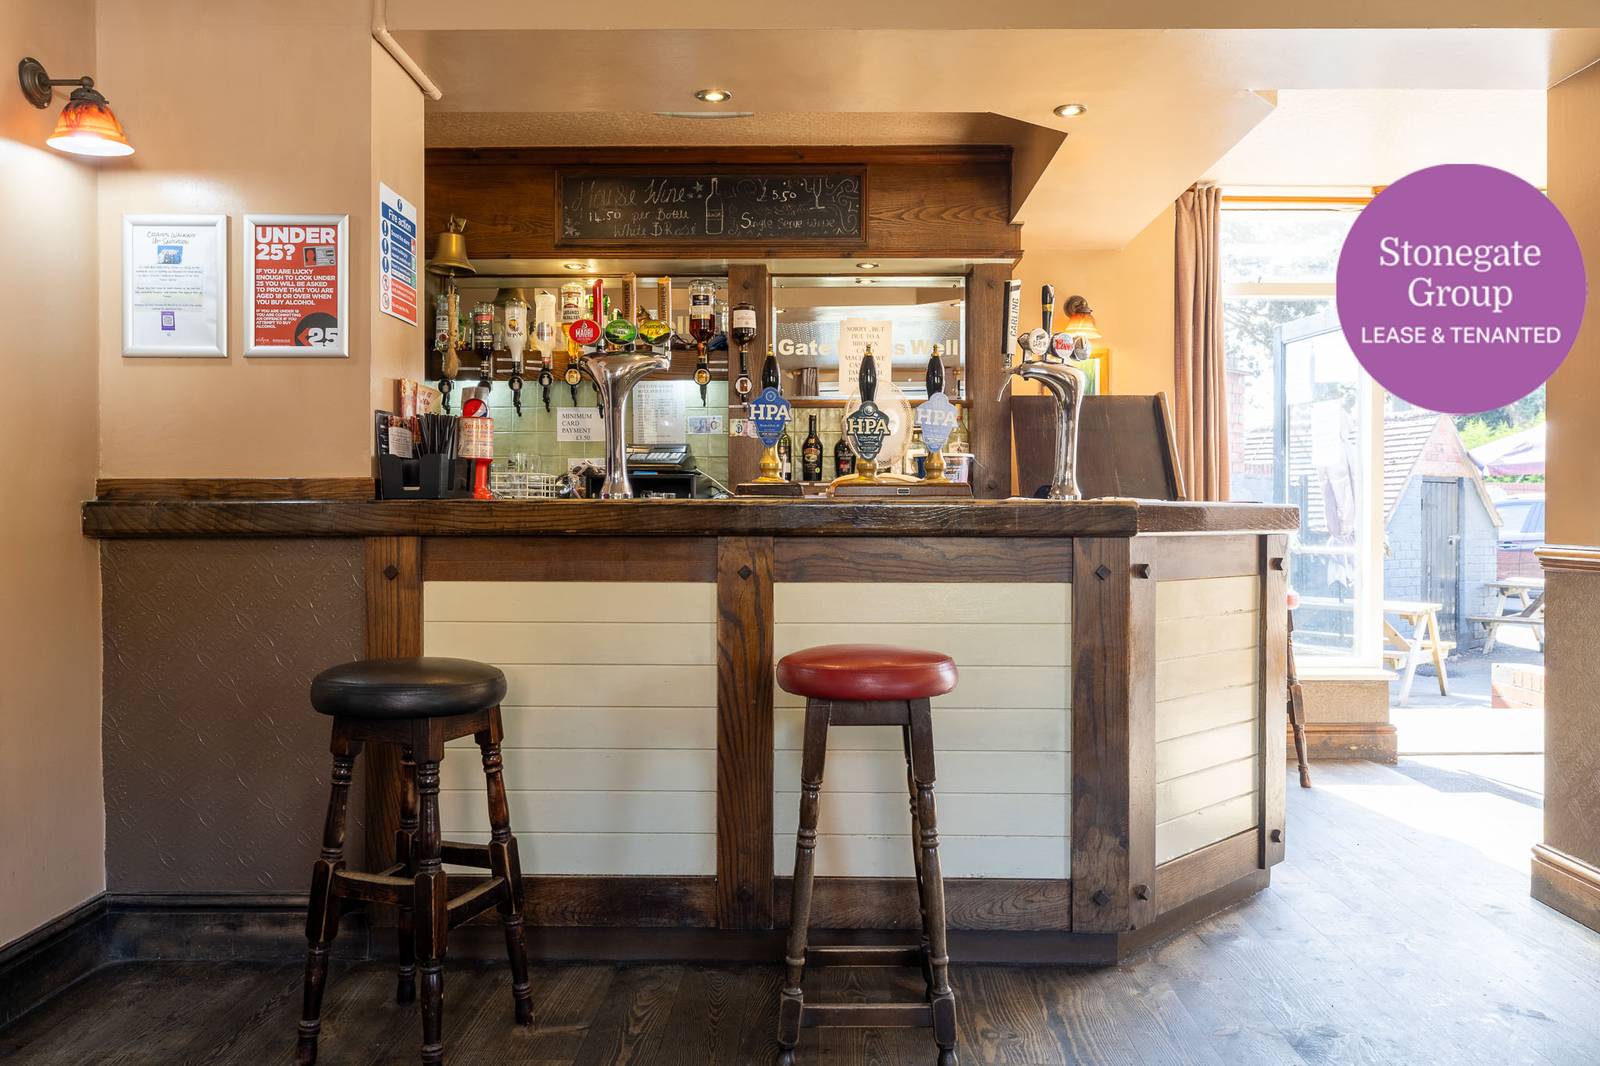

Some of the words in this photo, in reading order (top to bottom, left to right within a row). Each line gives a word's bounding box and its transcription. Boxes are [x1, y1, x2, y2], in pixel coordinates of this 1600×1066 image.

[643, 179, 686, 204] Wine
[388, 208, 398, 223] Fire
[397, 217, 412, 233] action
[657, 208, 689, 221] Bottle
[740, 212, 773, 231] Single
[256, 226, 336, 244] UNDER
[256, 244, 296, 261] 25?
[1010, 298, 1019, 337] CARLING
[778, 338, 833, 356] Gate
[911, 338, 959, 356] Well
[749, 404, 792, 421] HPA
[916, 409, 959, 428] HPA
[847, 418, 891, 435] HPA
